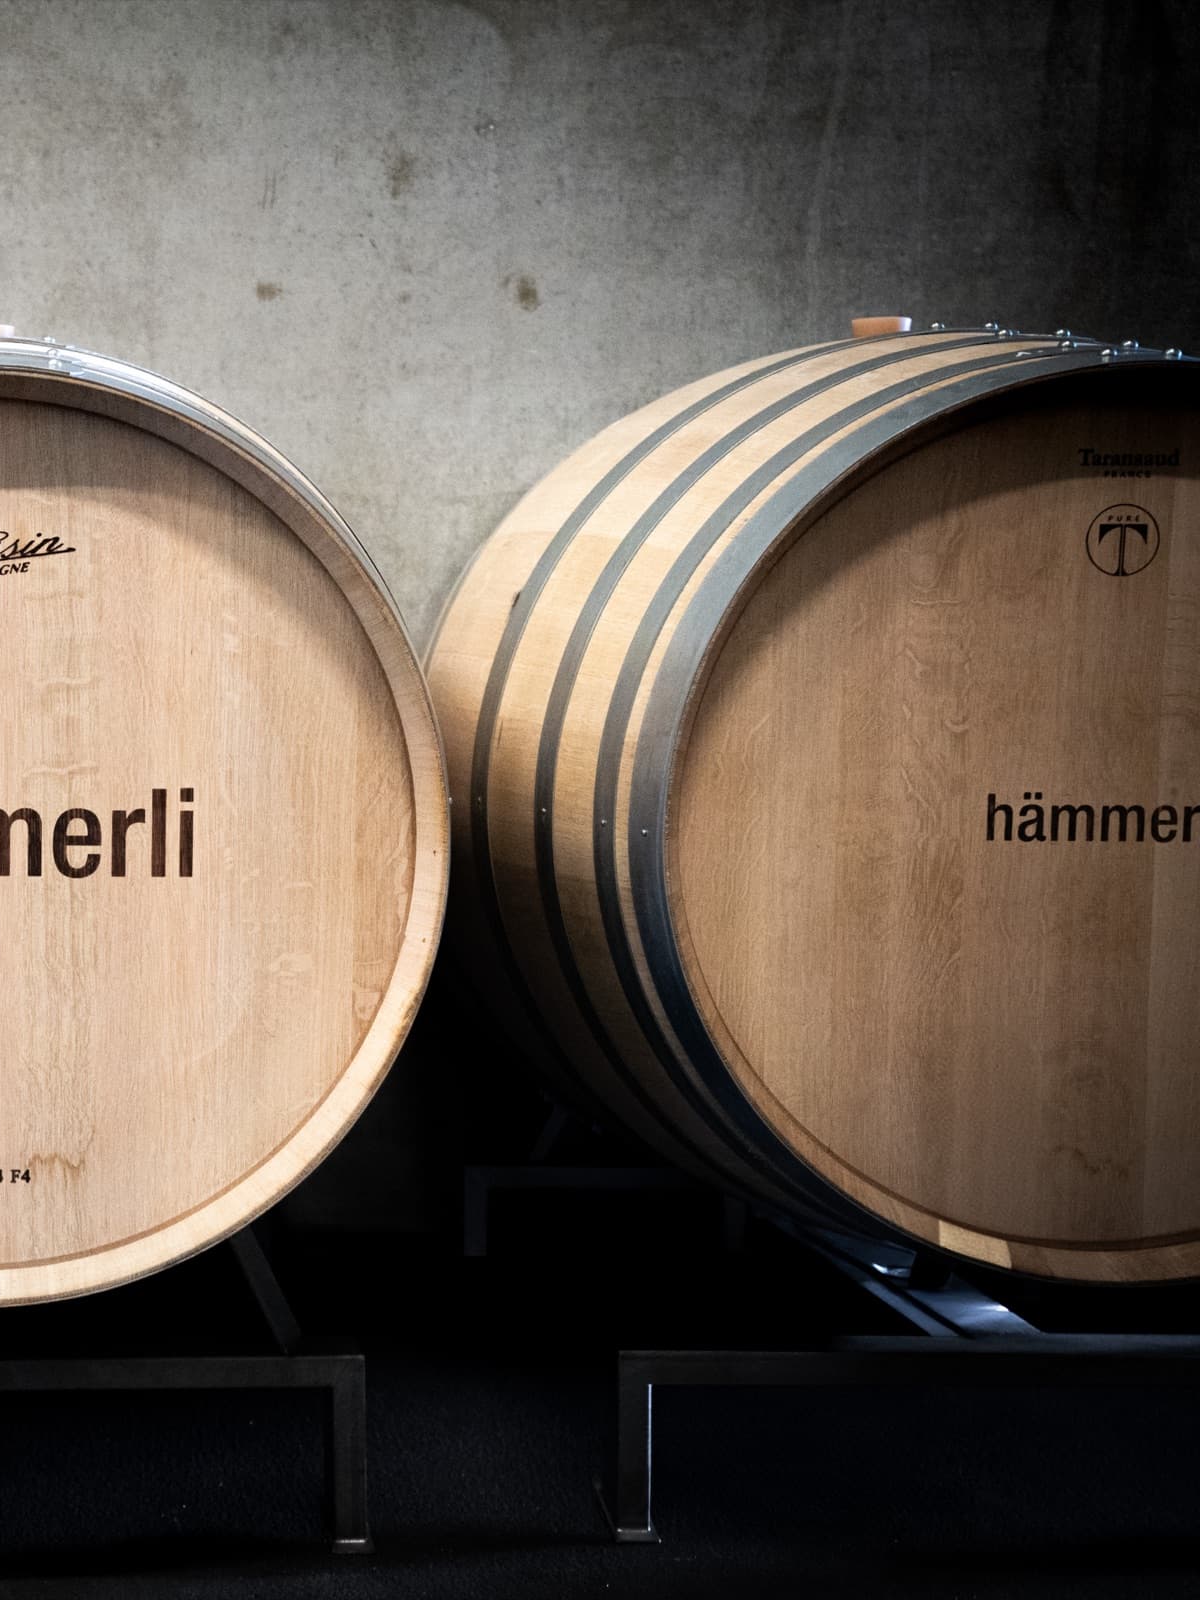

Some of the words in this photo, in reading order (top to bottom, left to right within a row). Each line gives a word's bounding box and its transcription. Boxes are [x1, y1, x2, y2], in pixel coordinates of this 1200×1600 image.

[1078, 448, 1182, 466] Taransaud
[1104, 470, 1152, 478] FRANCE
[10, 1169, 32, 1183] F4
